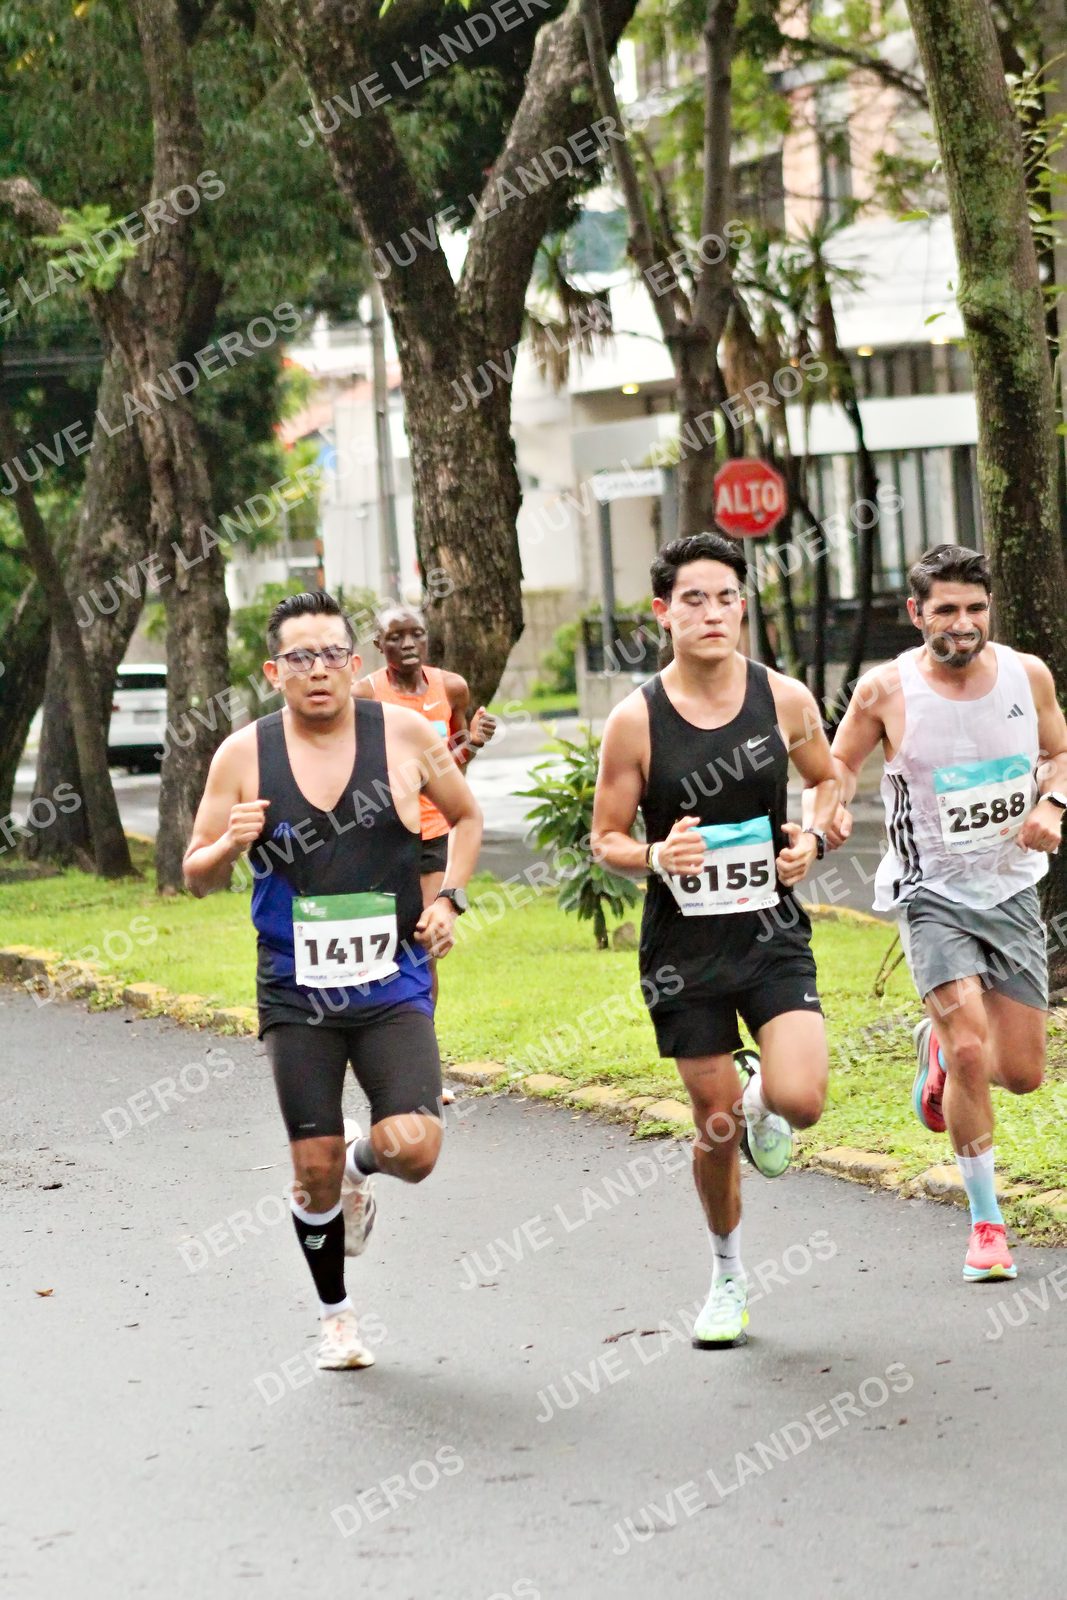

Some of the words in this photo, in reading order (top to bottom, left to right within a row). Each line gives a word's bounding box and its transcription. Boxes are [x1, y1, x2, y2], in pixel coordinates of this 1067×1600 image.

[715, 480, 780, 516] ALTO
[946, 792, 1025, 833] 2588
[680, 859, 769, 894] 6155
[305, 933, 390, 966] 1417
